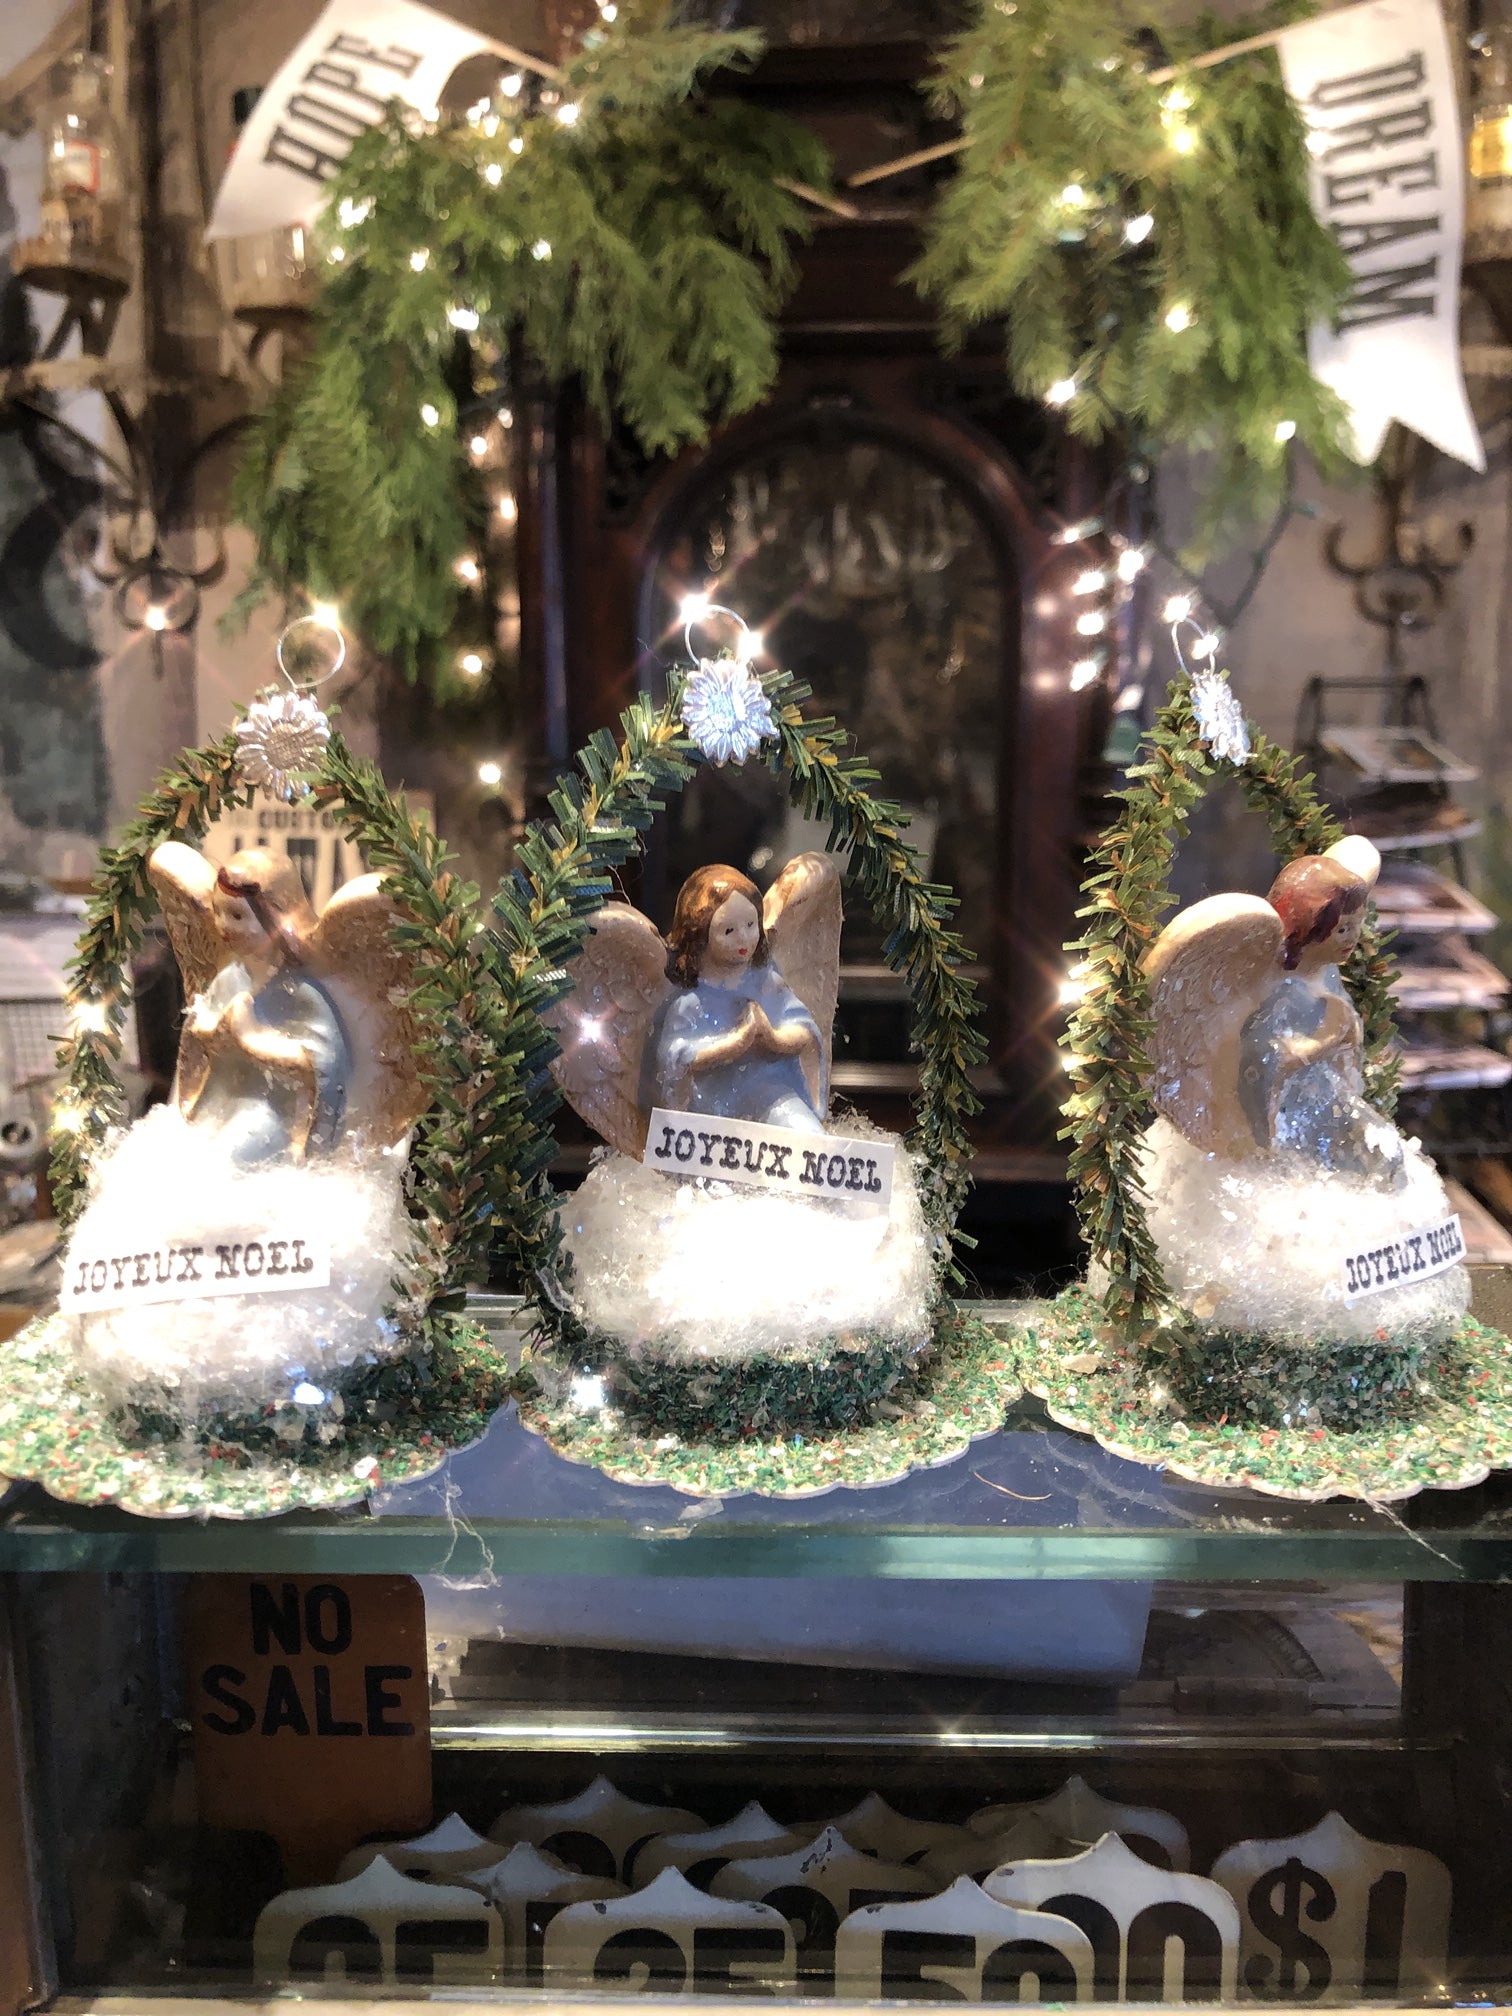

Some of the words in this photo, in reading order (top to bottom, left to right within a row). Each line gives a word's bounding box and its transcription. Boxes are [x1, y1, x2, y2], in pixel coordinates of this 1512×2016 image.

[262, 32, 425, 184] HOPE
[1310, 50, 1442, 336] DREAM
[654, 1126, 793, 1180] JOYEUX
[798, 1150, 883, 1194] NOEL
[73, 1246, 204, 1295] JOYEUX
[214, 1239, 314, 1281] NOEL
[1345, 1235, 1426, 1293] JOYEUX
[1426, 1221, 1462, 1266] NOEL
[251, 1582, 352, 1656] NO
[202, 1664, 416, 1736] SALE
[1244, 1856, 1408, 2002] $1
